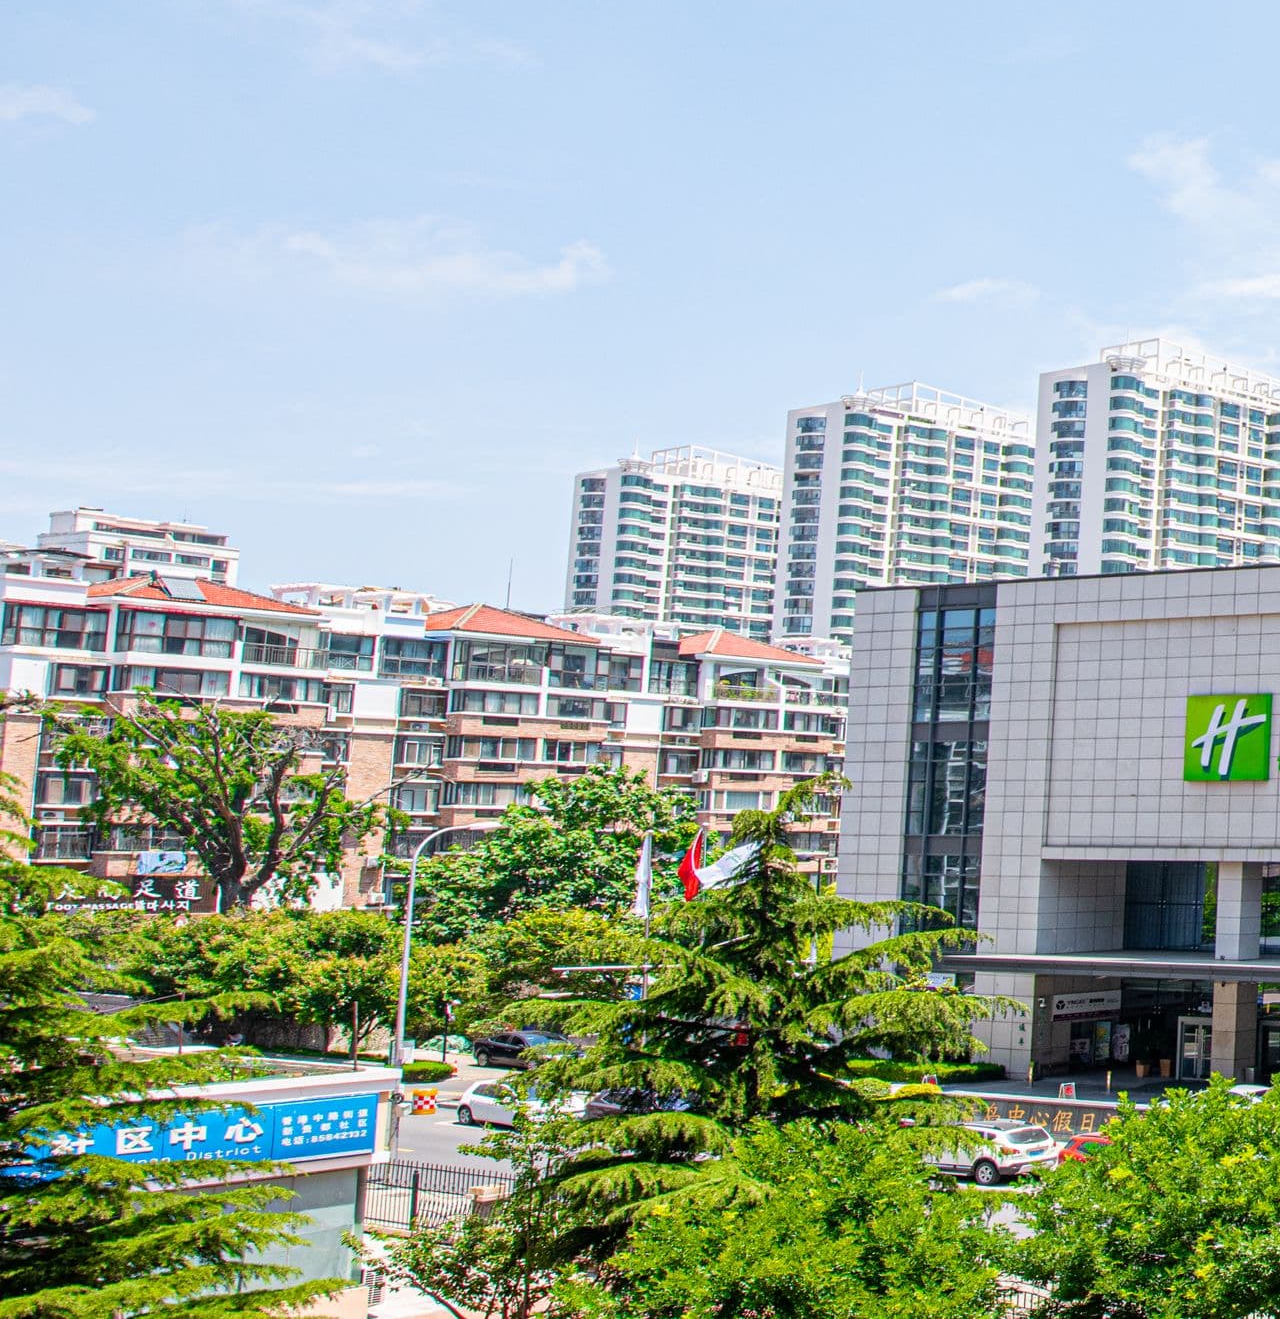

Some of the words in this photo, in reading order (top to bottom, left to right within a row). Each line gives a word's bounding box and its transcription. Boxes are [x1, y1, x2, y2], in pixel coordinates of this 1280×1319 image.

[52, 1117, 264, 1156] 社区中心
[186, 1144, 262, 1161] District
